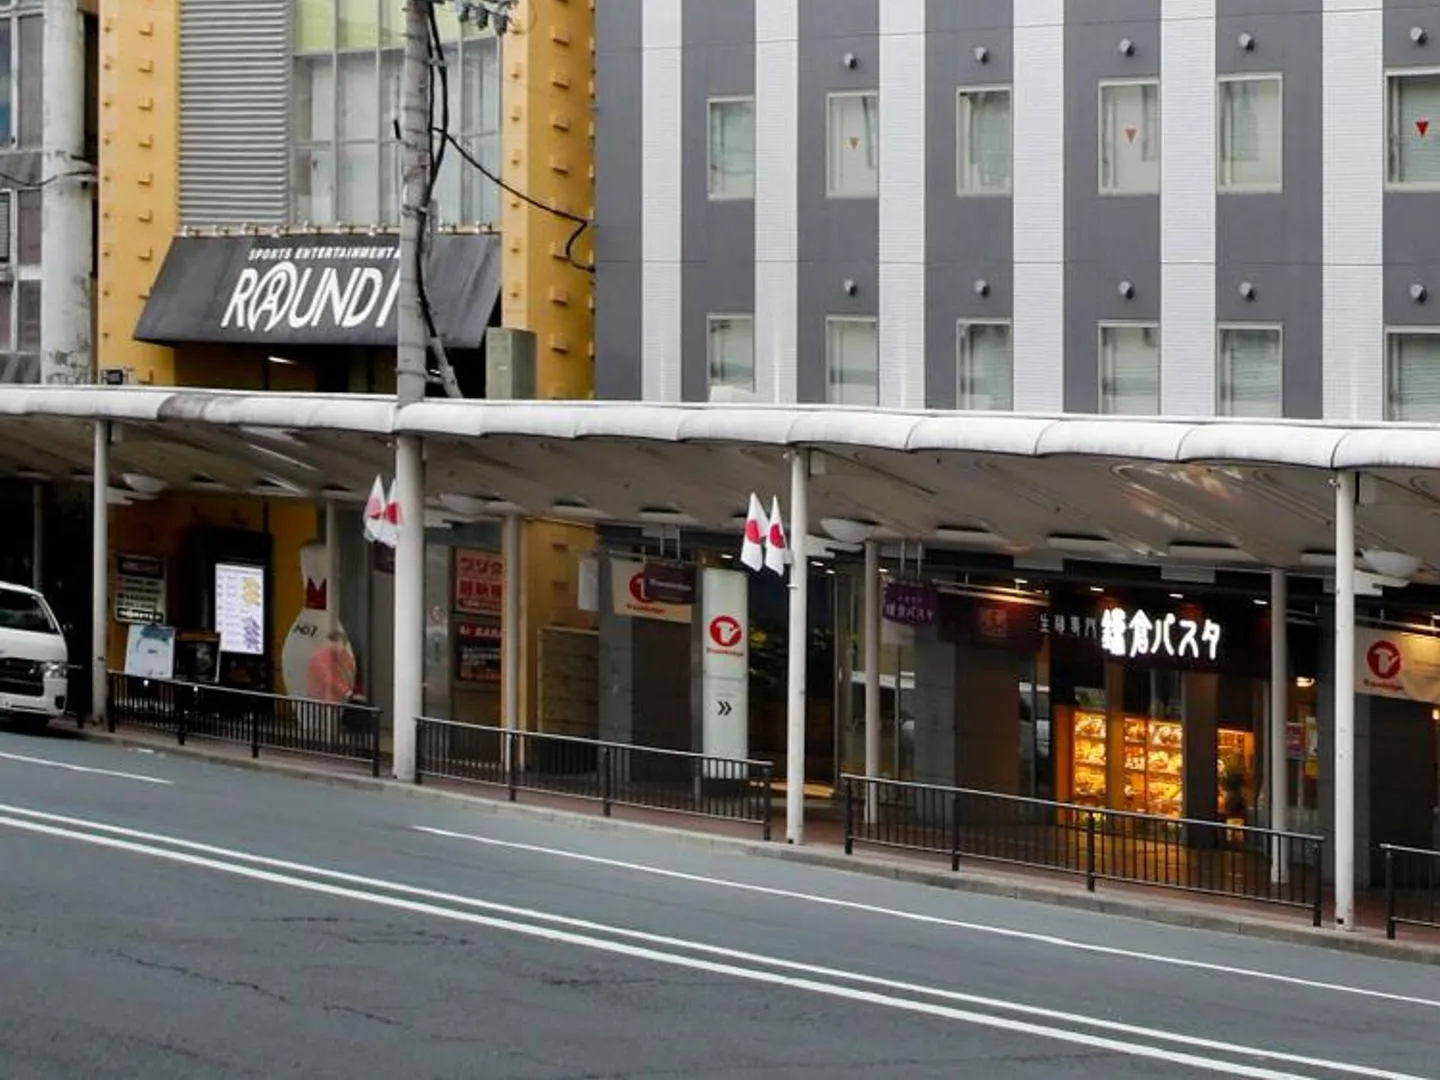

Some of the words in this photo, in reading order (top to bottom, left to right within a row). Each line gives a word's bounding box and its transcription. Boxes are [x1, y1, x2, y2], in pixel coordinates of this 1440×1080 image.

[248, 247, 292, 261] SPORTS
[294, 247, 394, 259] ENTERTAINMENT
[1101, 607, 1221, 660] 鎌倉パスタ
